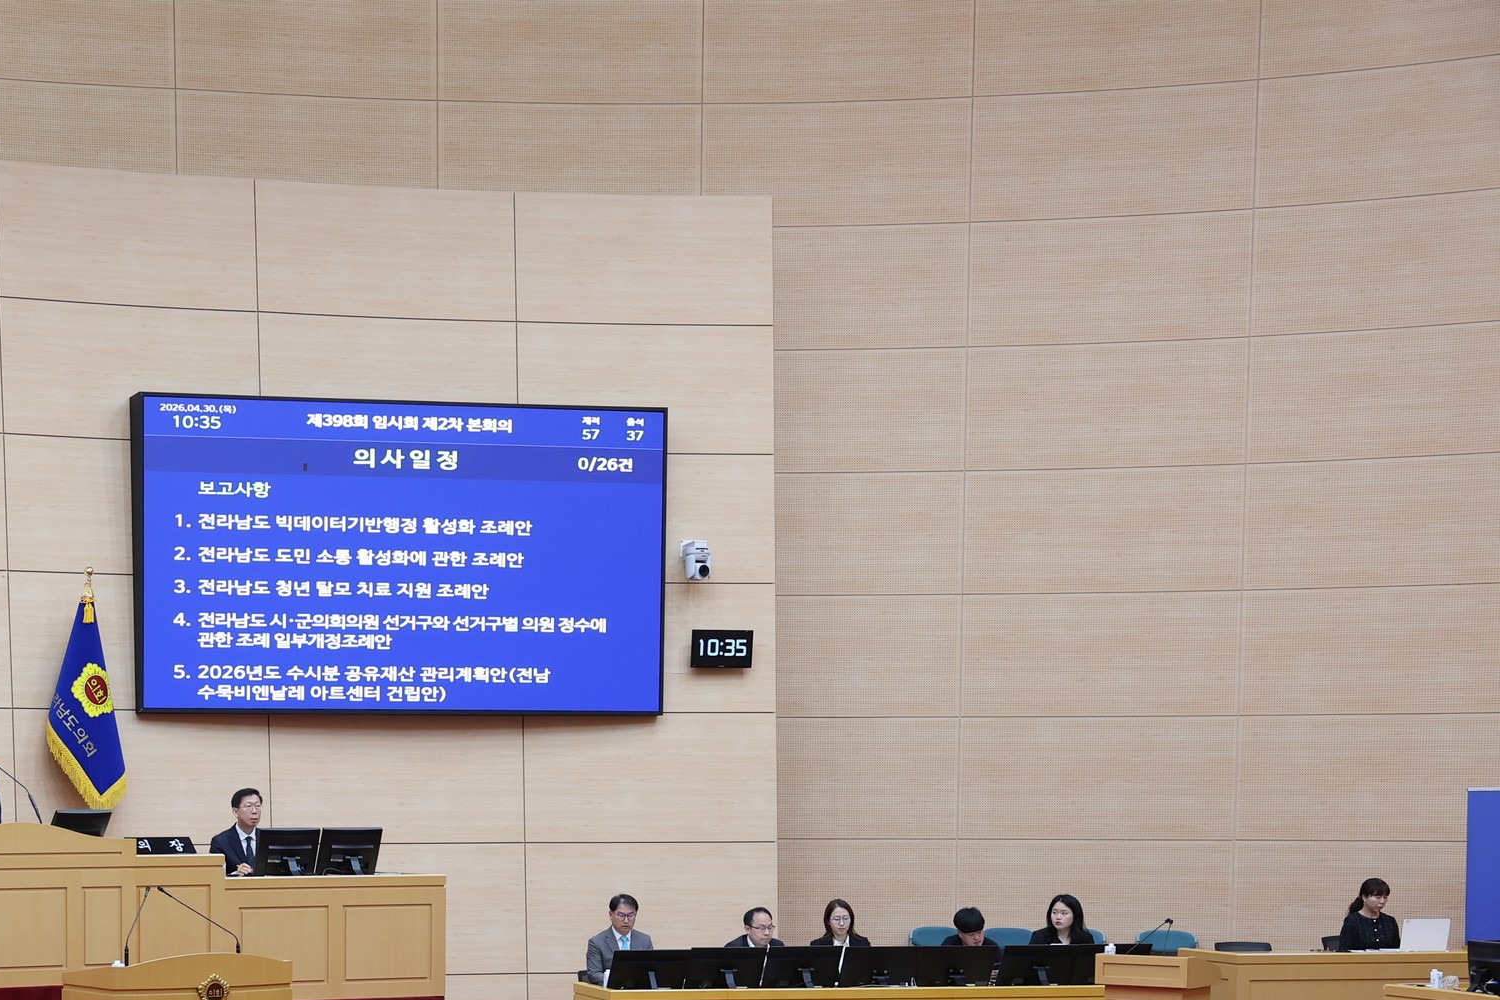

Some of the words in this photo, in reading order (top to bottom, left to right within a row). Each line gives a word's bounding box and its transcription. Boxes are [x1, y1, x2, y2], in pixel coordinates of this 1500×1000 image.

[160, 403, 236, 414] 2026.04.30.(목)
[173, 415, 221, 429] 10:35
[307, 414, 368, 429] 제398회
[373, 416, 418, 430] 임시회
[422, 417, 464, 432] 제2차
[466, 418, 512, 433] 본회의
[582, 429, 599, 440] 57
[627, 430, 644, 441] 37
[353, 448, 457, 470] 의사일정
[578, 457, 632, 472] 0/26건
[198, 482, 271, 498] 보고사항
[175, 514, 191, 527] 1.
[198, 514, 271, 530] 전라남도
[276, 515, 417, 534] 빅데이터기반행정
[423, 518, 475, 534] 활성화
[480, 521, 532, 536] 조례안
[174, 547, 191, 560] 2.
[198, 547, 270, 563] 전라남도
[275, 549, 310, 564] 도민
[316, 549, 352, 565] 소통
[356, 549, 426, 566] 활성화에
[432, 551, 467, 567] 관한
[471, 553, 524, 568] 조례안
[174, 579, 191, 593] 3.
[198, 579, 270, 595] 전라남도
[276, 580, 310, 596] 청년
[316, 581, 352, 597] 탈모
[357, 582, 392, 597] 치료
[397, 583, 431, 598] 지원
[436, 584, 489, 599] 조례안
[173, 613, 190, 626] 4.
[198, 612, 267, 628] 전라남도
[383, 615, 450, 631] 선거구와
[453, 616, 518, 632] 선거구별
[522, 617, 554, 632] 의원
[558, 617, 606, 633] 정수에
[197, 632, 233, 648] 관한
[236, 633, 270, 648] 조례
[274, 633, 392, 649] 일부개정조례안
[699, 639, 747, 657] 10:35
[174, 665, 190, 678] 5.
[198, 665, 282, 680] 2026년도
[286, 666, 340, 681] 수시분
[344, 666, 416, 682] 공유재산
[86, 678, 107, 704] 의회
[197, 685, 304, 700] 수묵비엔날레
[310, 686, 380, 701] 아트센터
[387, 686, 446, 702] 건립안)
